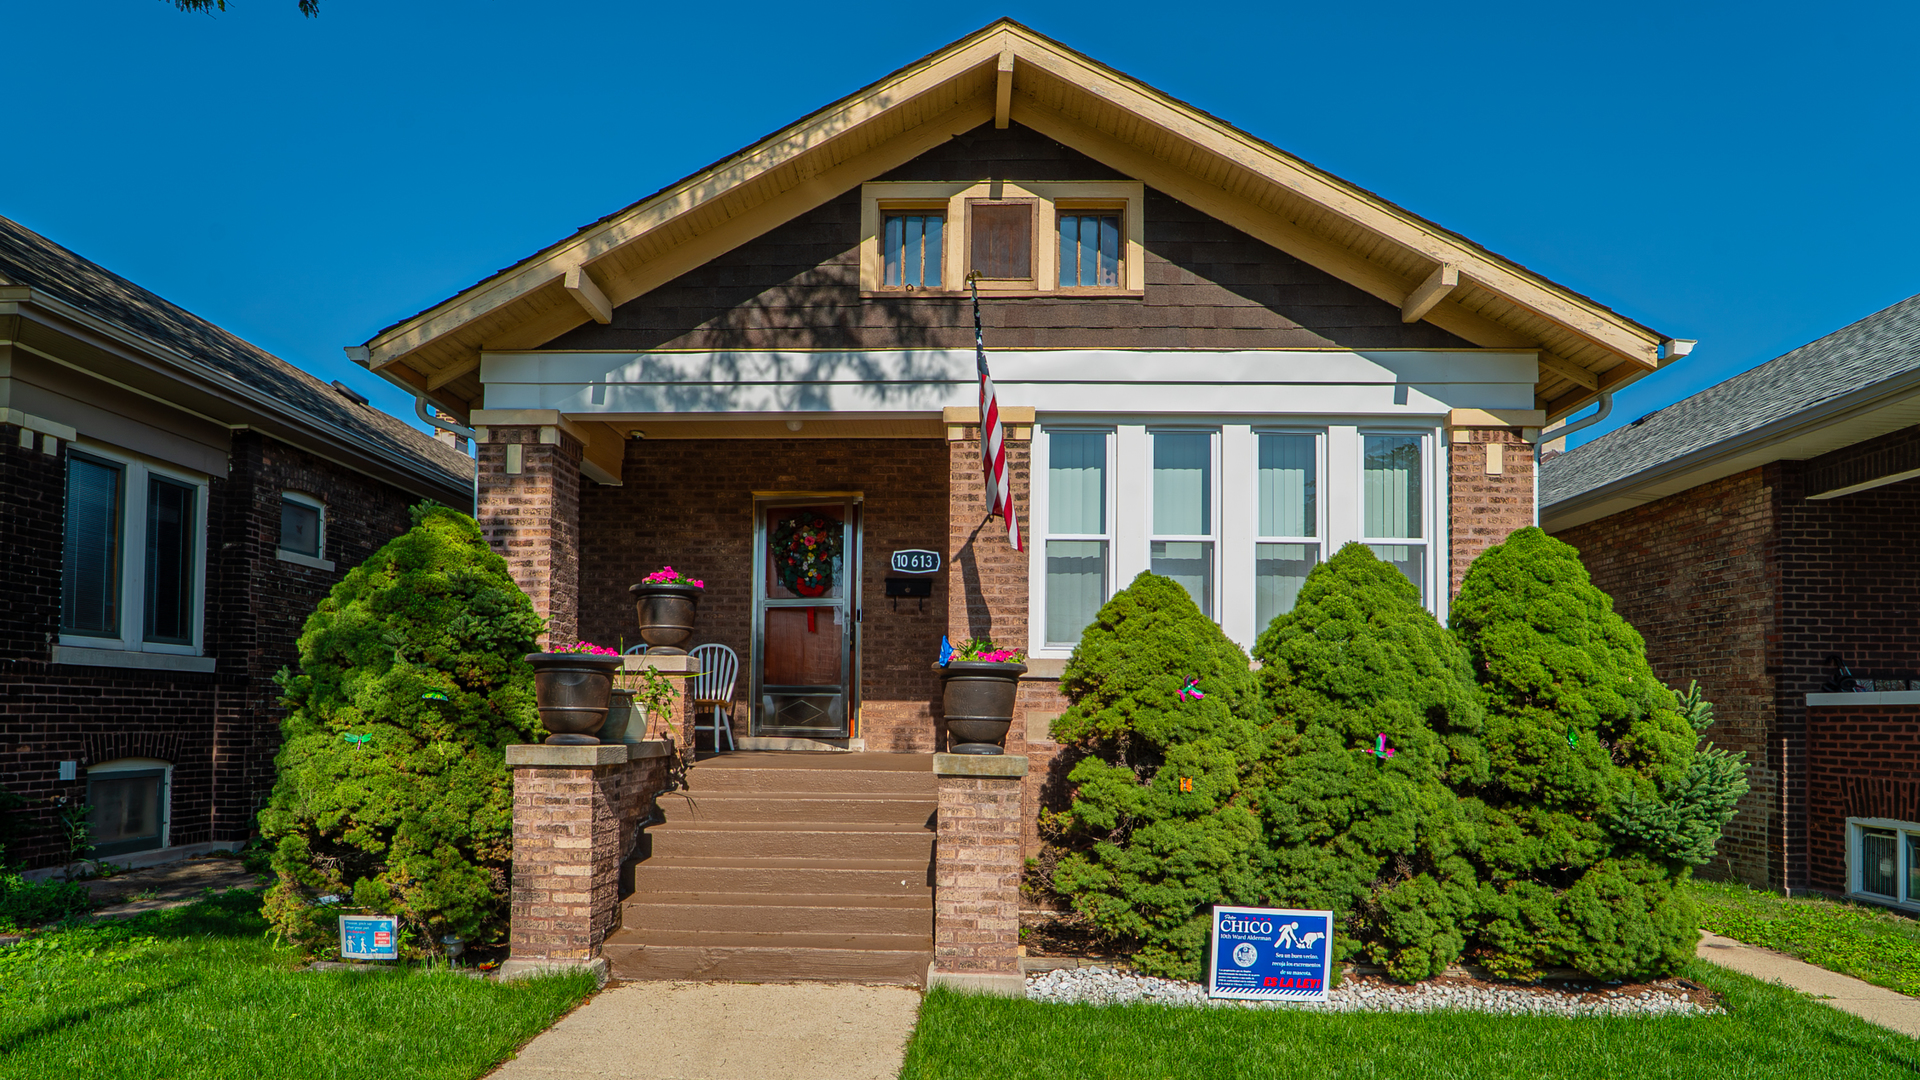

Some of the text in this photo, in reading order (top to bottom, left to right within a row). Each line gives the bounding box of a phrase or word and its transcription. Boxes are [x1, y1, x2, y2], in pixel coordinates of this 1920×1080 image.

[896, 554, 932, 568] 10 613
[1220, 920, 1272, 934] CHICO
[1263, 977, 1278, 987] ES
[1279, 977, 1294, 988] LA
[1296, 978, 1321, 988] LEY!
